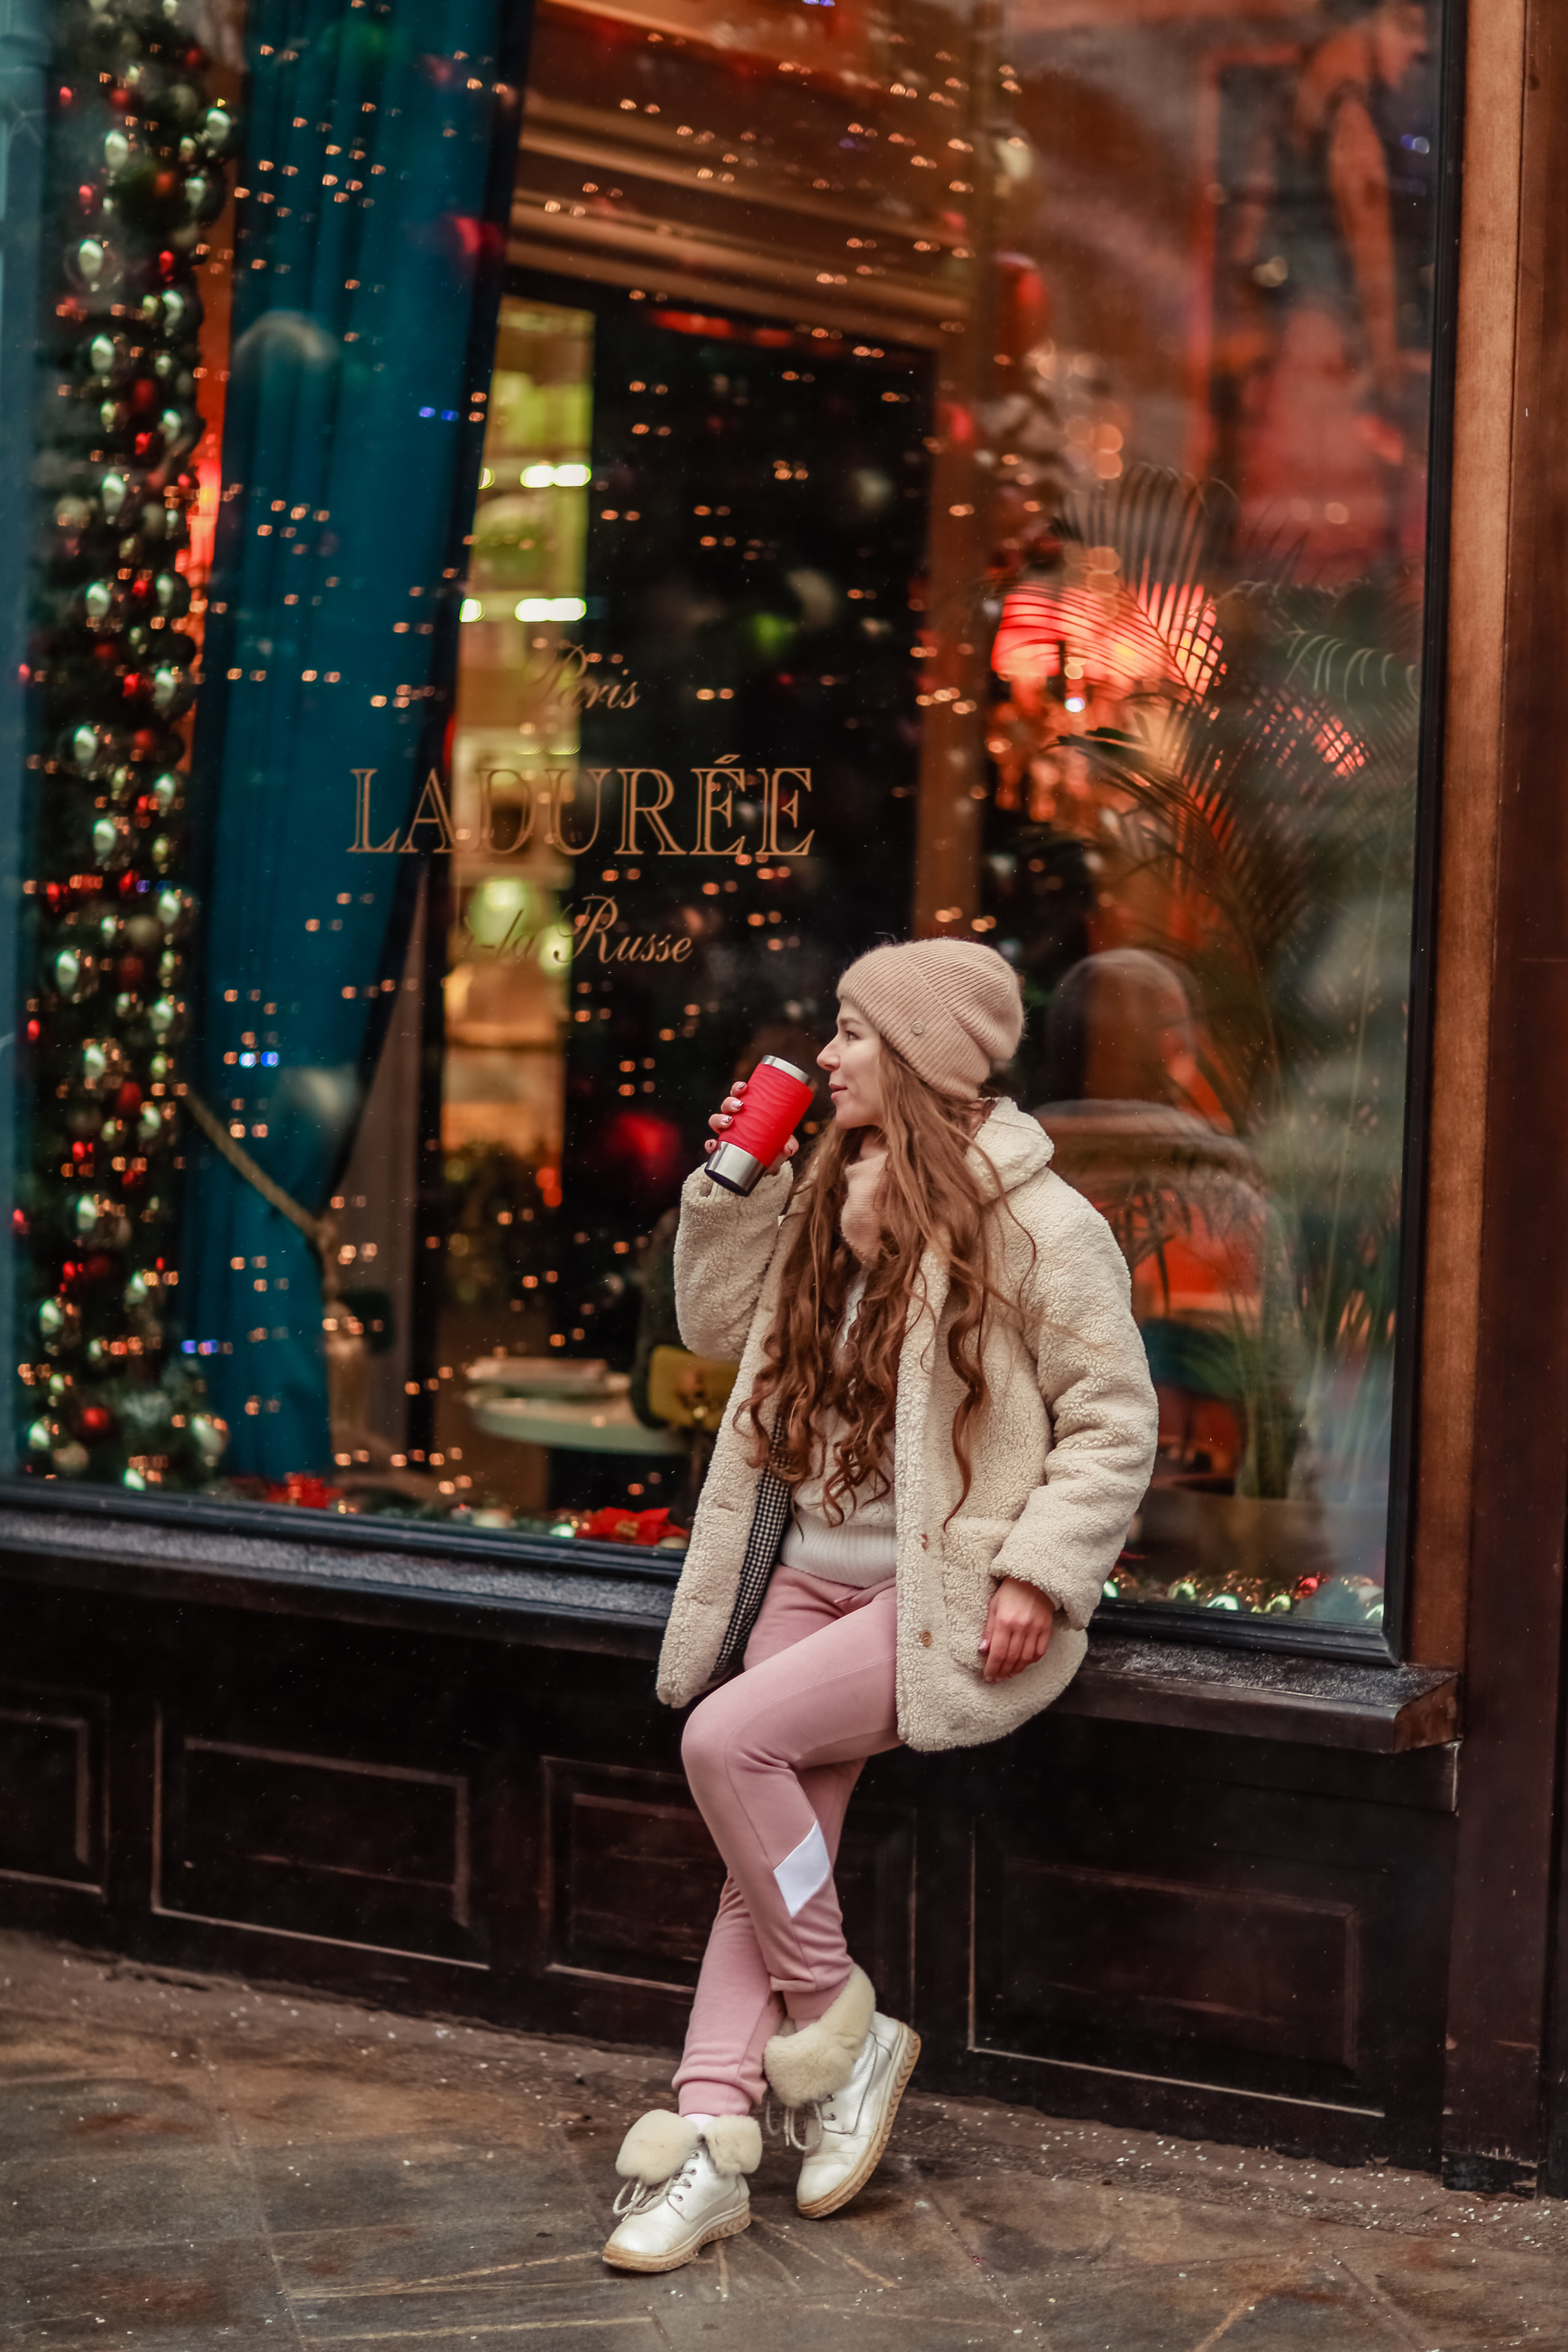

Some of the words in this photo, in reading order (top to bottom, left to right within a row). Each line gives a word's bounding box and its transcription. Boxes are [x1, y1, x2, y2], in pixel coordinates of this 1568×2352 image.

[522, 644, 640, 709] Paris
[346, 755, 815, 856] LADURÉE
[553, 895, 693, 963] Russe
